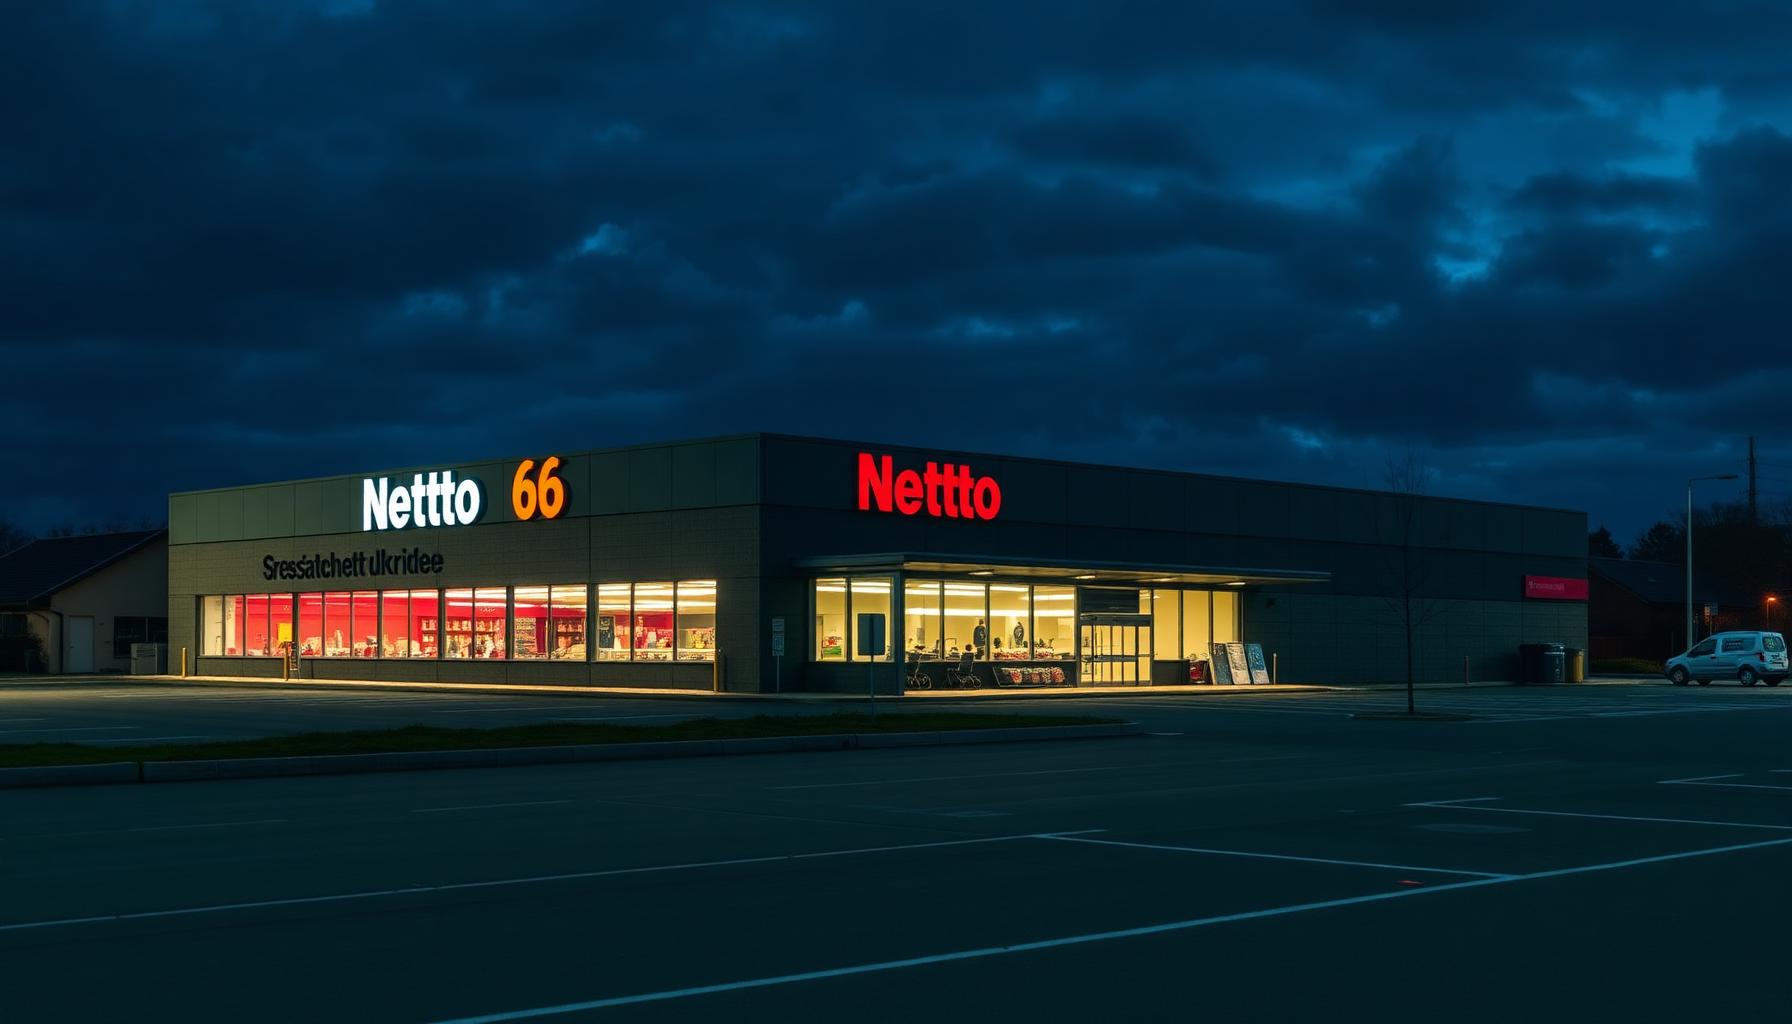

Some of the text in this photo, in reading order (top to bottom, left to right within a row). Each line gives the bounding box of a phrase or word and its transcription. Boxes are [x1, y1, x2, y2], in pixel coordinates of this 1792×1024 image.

[362, 456, 566, 531] Nettto 66
[857, 453, 1002, 520] Nettto
